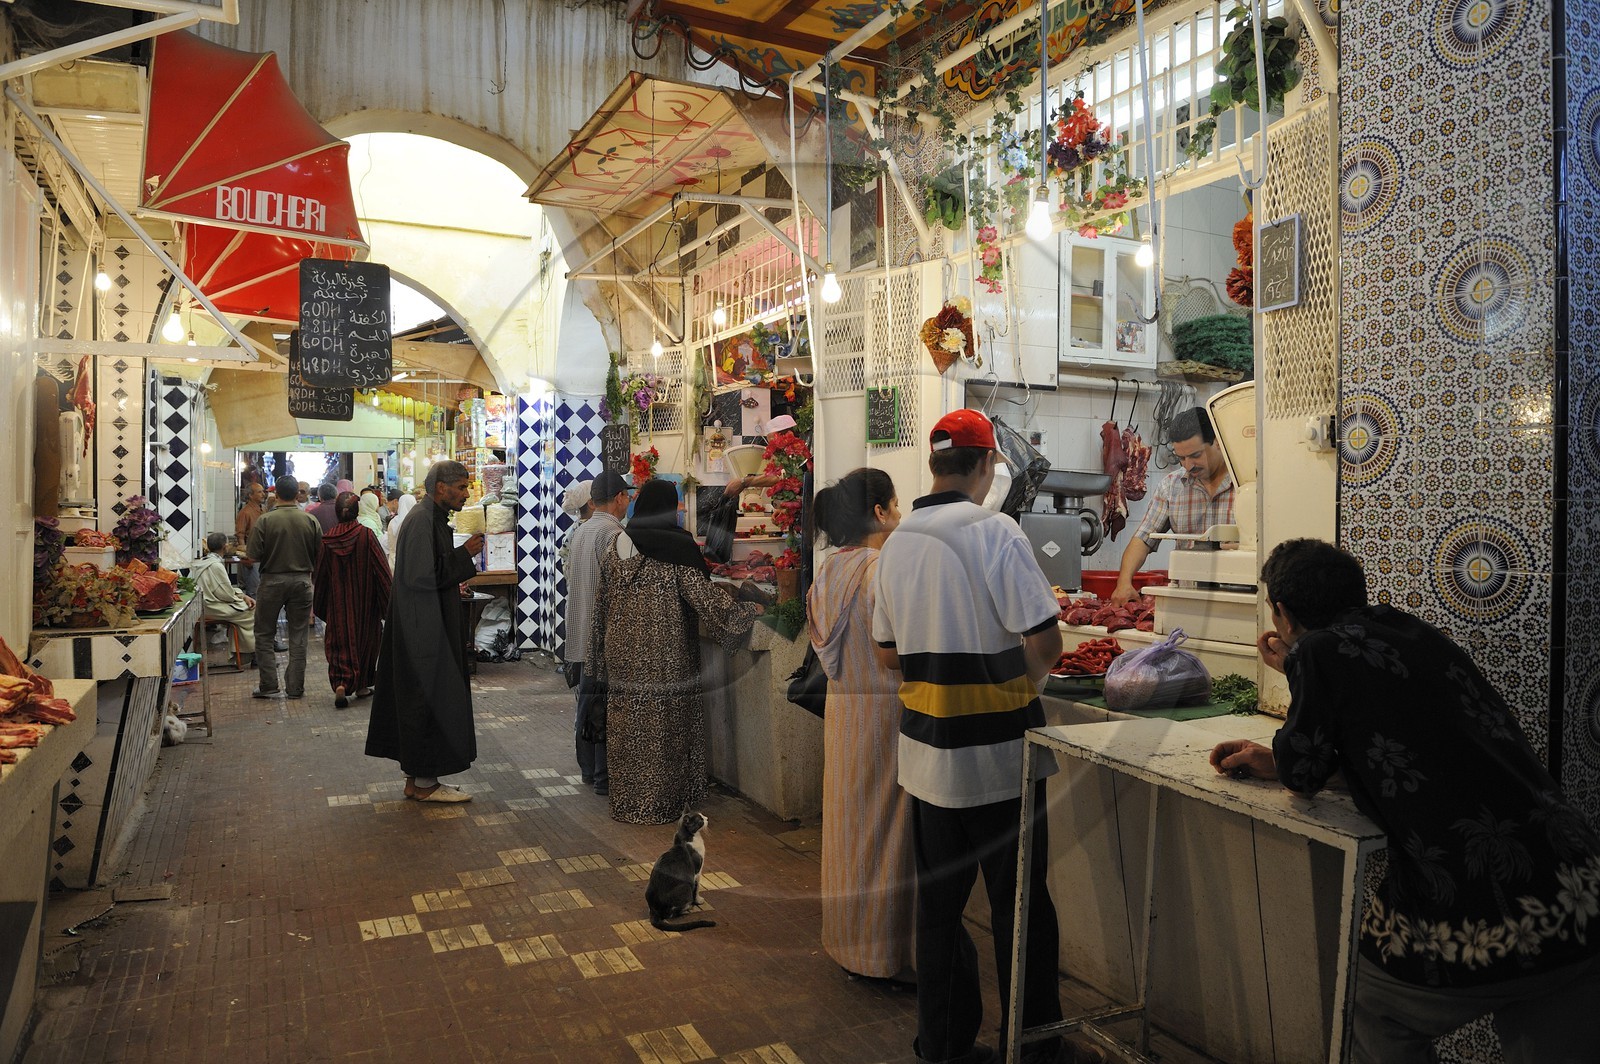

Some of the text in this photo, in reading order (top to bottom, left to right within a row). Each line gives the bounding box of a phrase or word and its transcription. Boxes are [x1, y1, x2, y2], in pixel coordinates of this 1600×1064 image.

[216, 186, 326, 232] BOUCHERI
[301, 300, 387, 325] الكفتة 60DH
[348, 329, 390, 343] اللحم
[301, 334, 391, 364] الهبرة 60DH
[302, 356, 342, 375] 48DH
